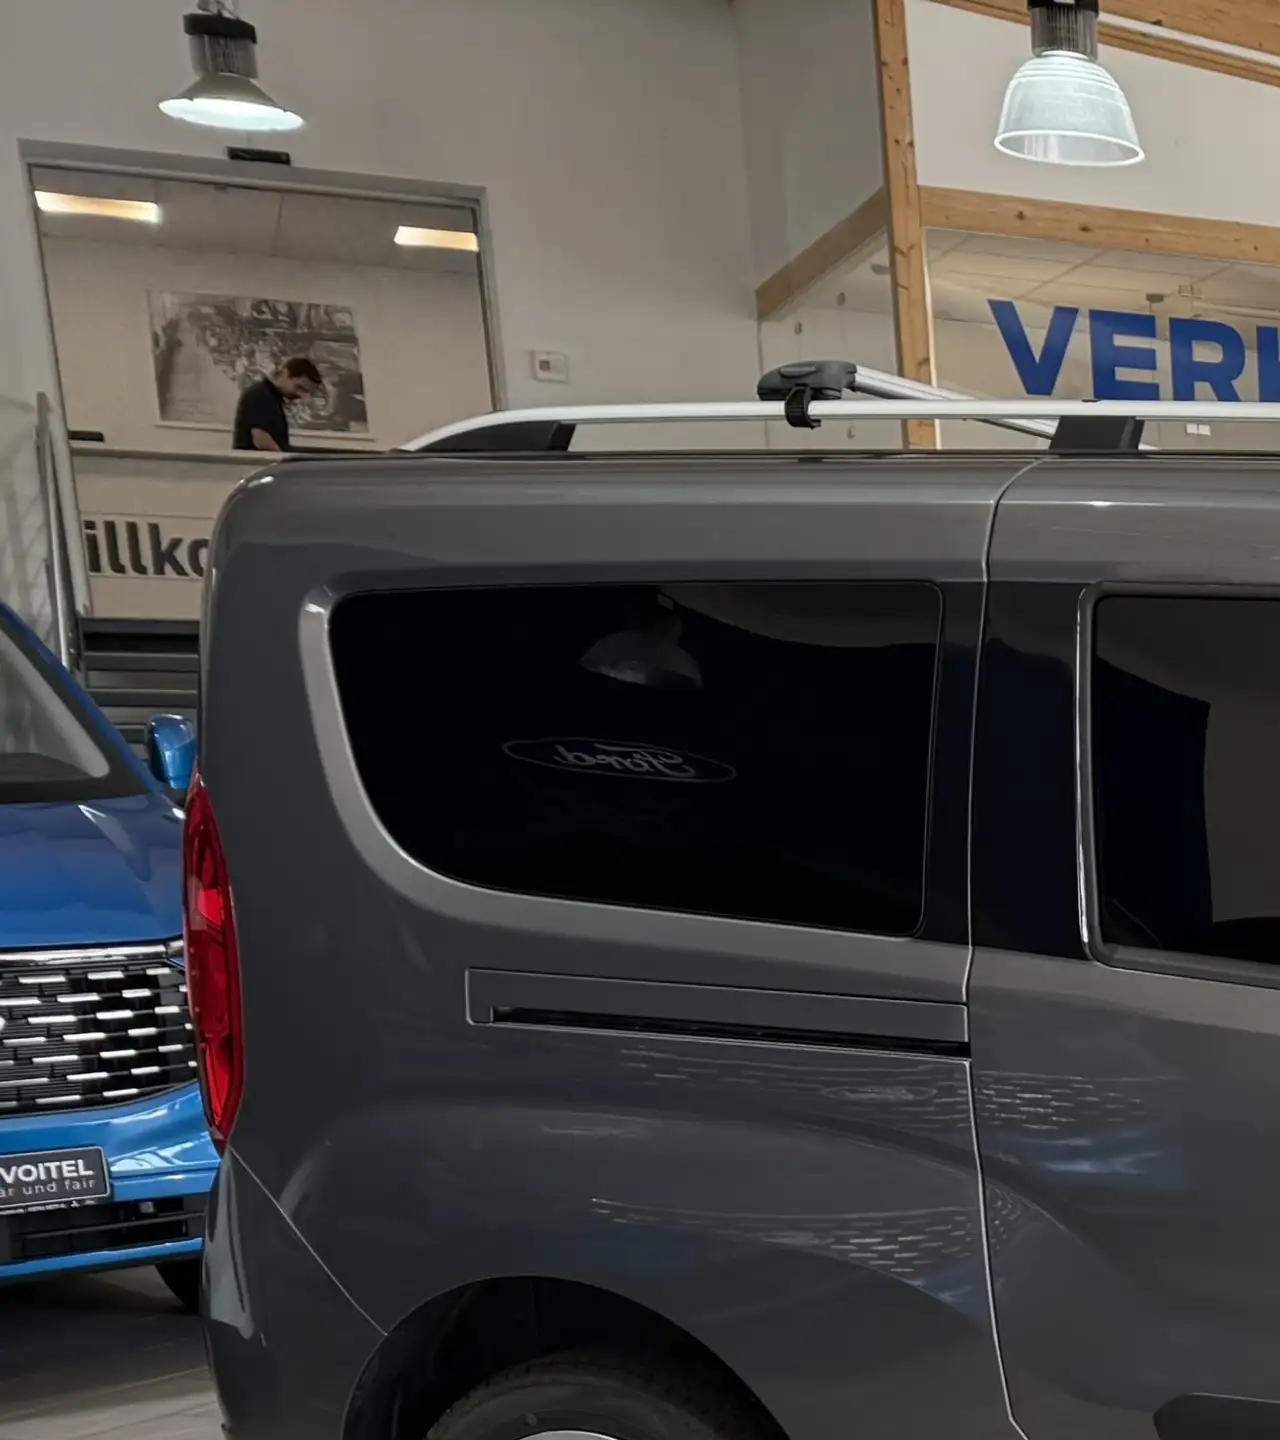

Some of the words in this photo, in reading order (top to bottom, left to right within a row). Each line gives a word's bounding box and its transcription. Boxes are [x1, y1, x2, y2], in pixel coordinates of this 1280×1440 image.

[0, 1159, 95, 1184] VOITEL
[22, 1180, 57, 1195] und
[65, 1179, 96, 1191] fair
